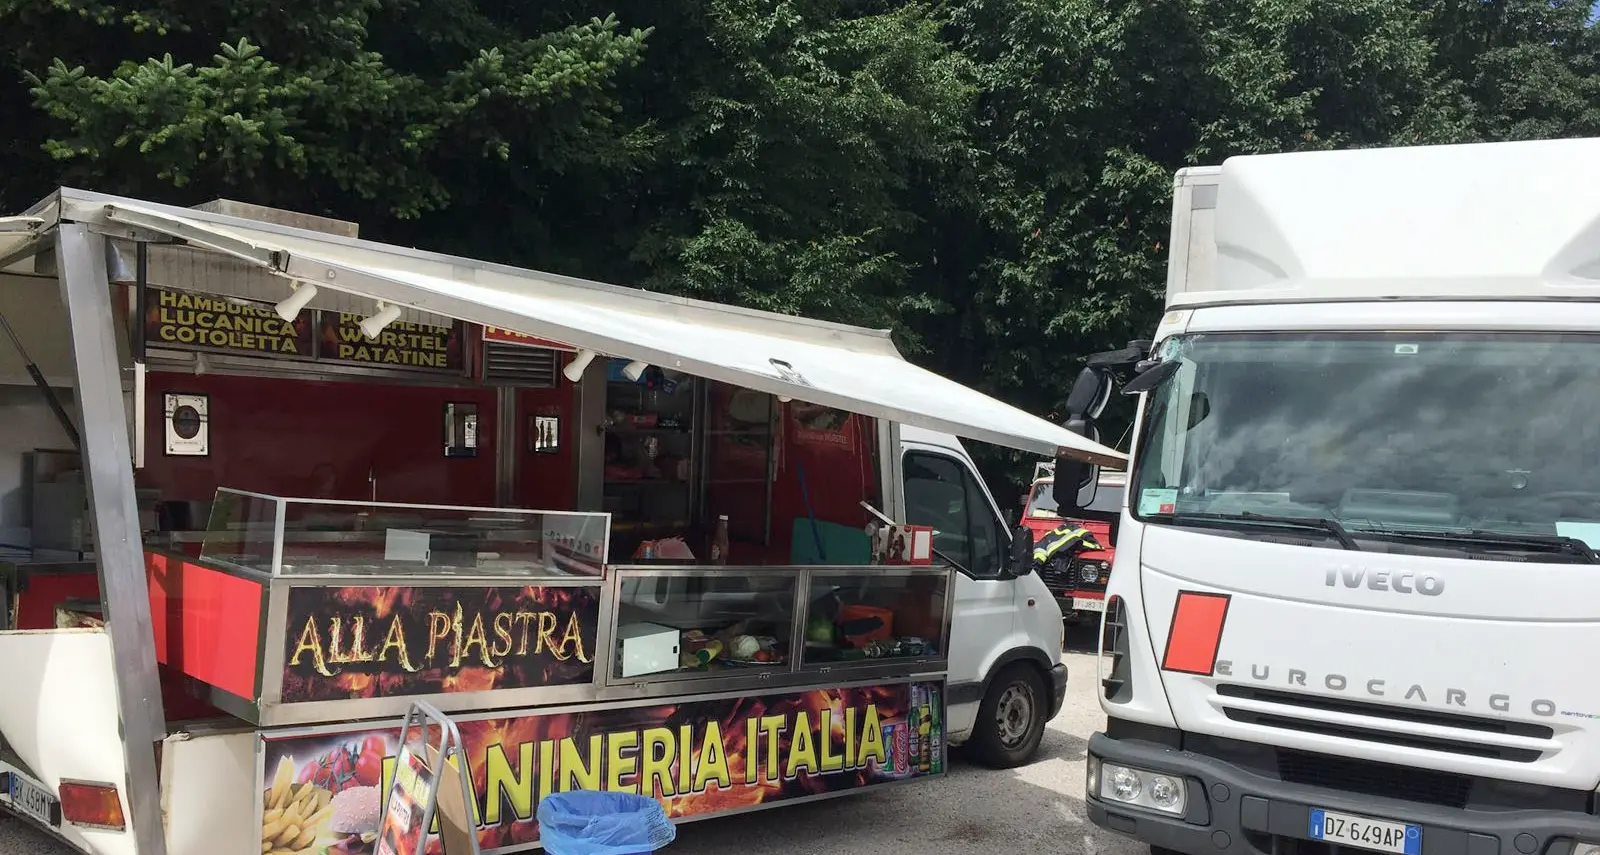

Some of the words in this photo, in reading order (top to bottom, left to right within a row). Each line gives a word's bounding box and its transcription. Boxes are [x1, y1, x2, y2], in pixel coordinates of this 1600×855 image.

[160, 308, 297, 336] LUCANICA
[160, 325, 297, 352] COTOLETTA
[340, 344, 447, 367] PATATINE
[1325, 563, 1445, 596] IVECO
[290, 614, 423, 677] ALLA
[425, 600, 592, 669] PIASTRA
[1215, 660, 1557, 717] EUROCARGO
[745, 703, 887, 786] ITALIA
[1325, 816, 1346, 838] DZ
[1350, 822, 1404, 848] 649AP
